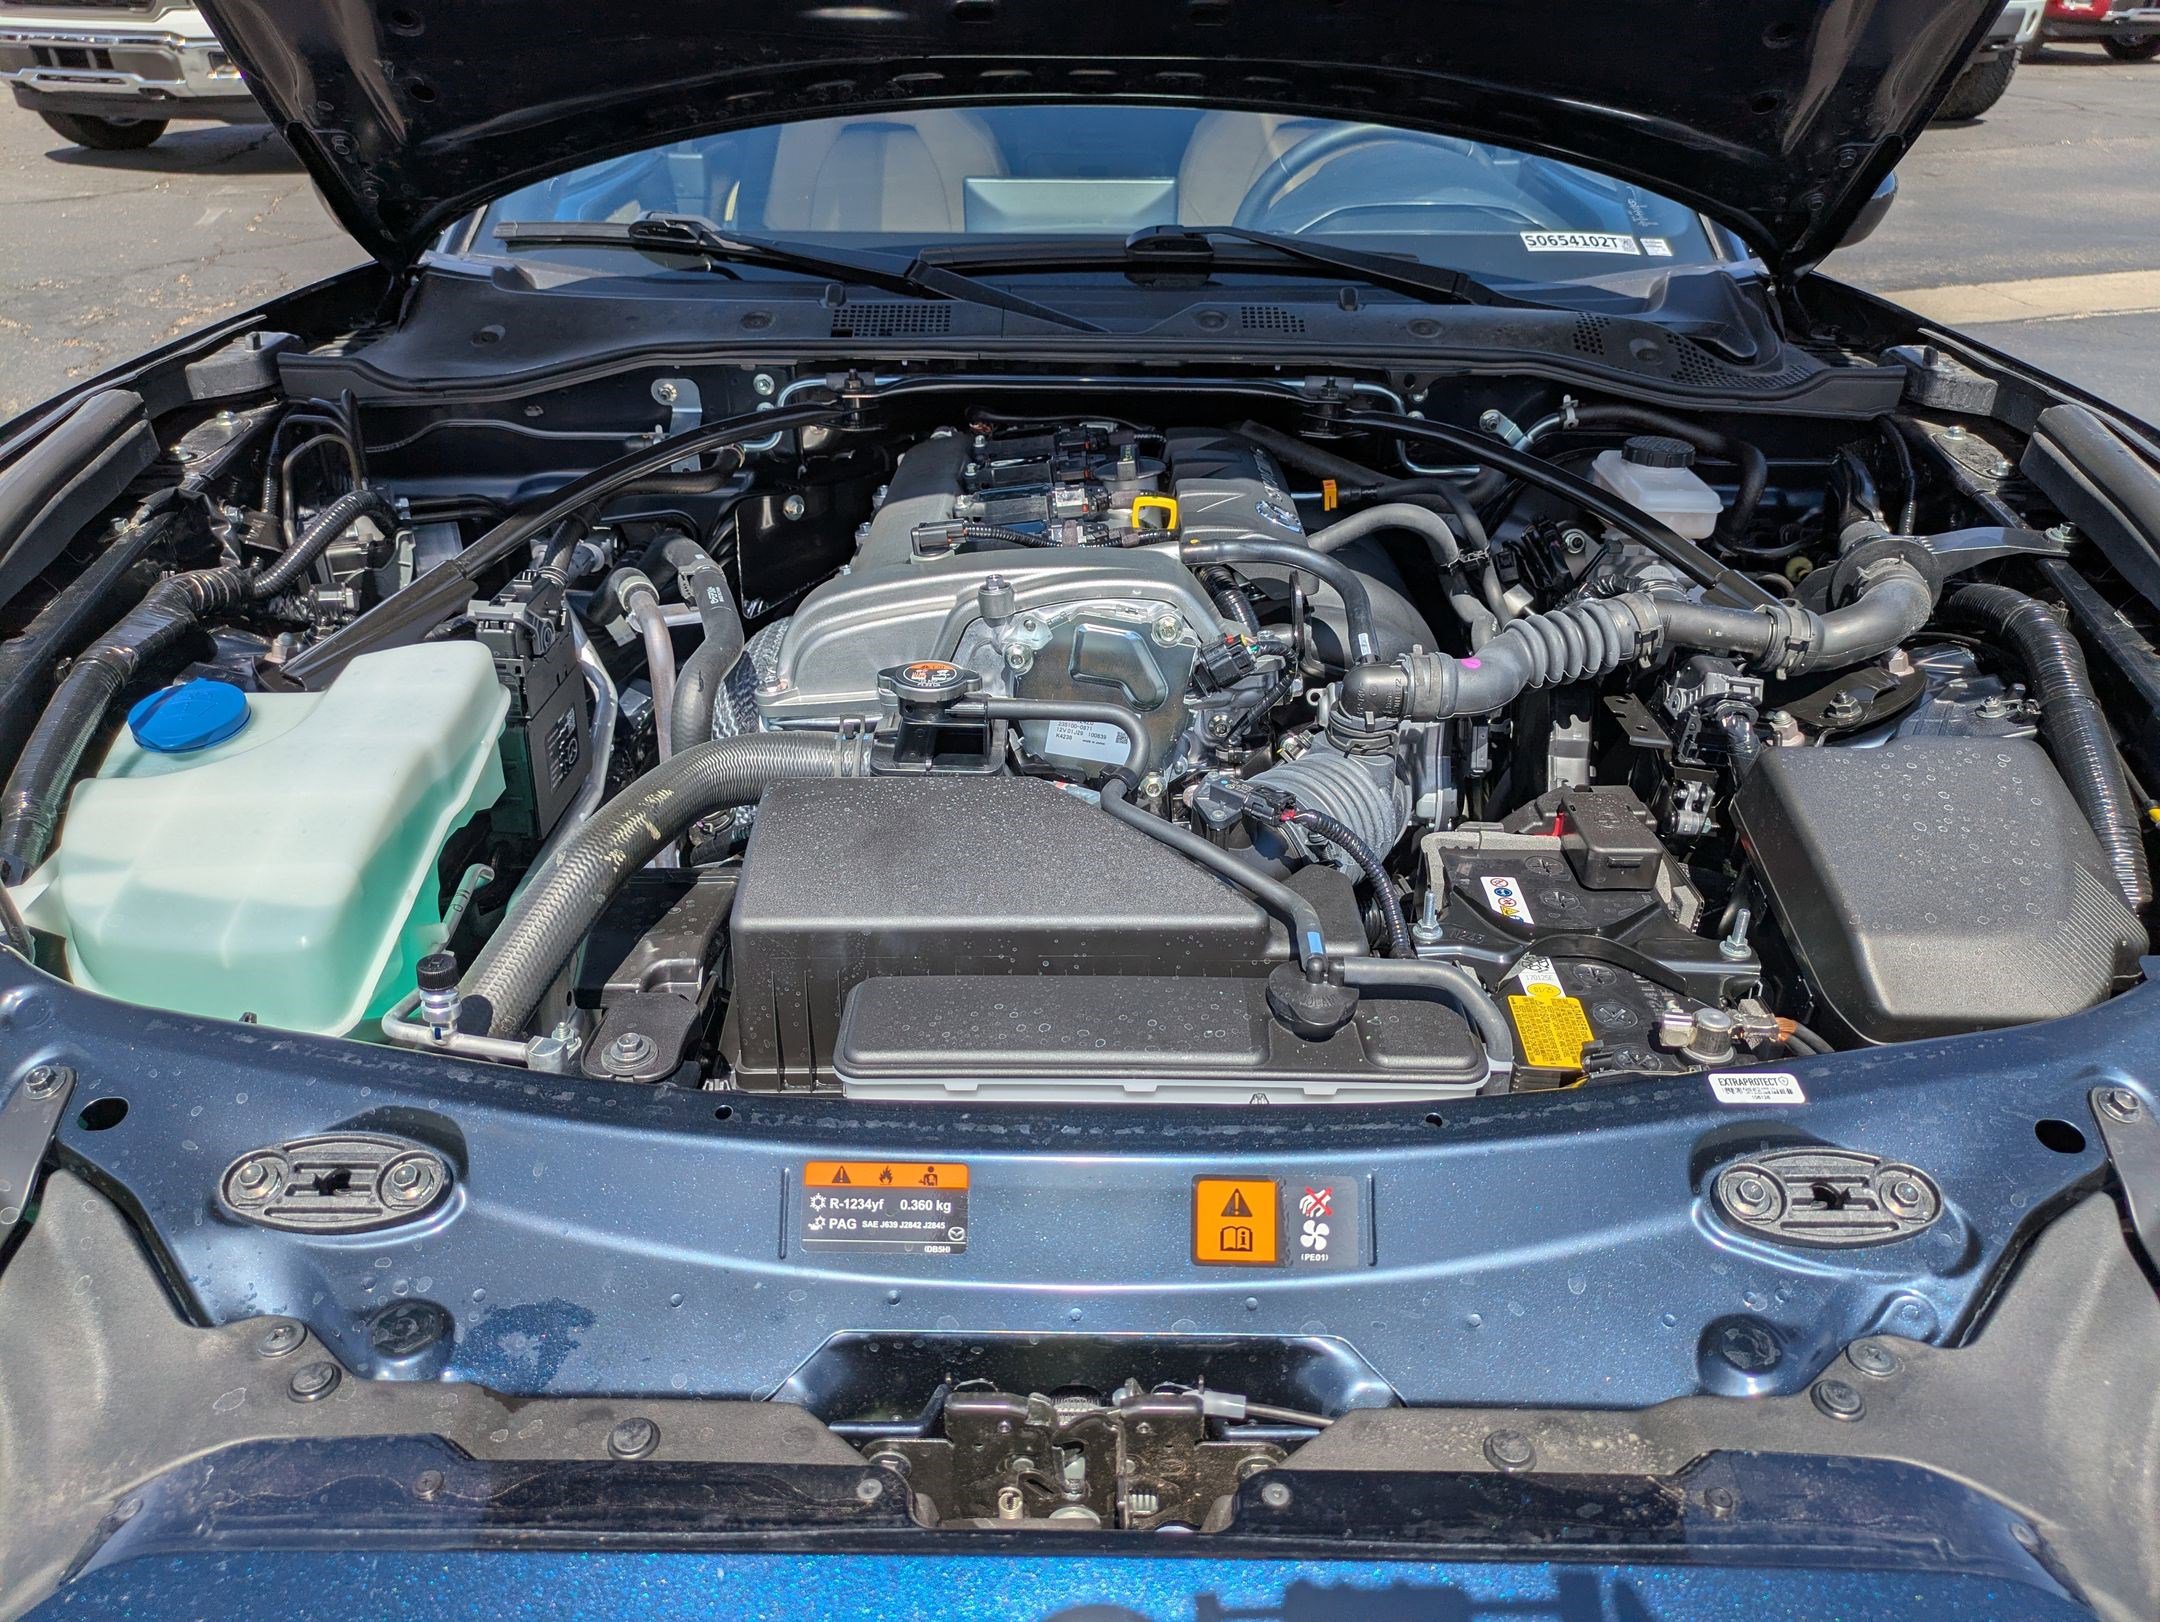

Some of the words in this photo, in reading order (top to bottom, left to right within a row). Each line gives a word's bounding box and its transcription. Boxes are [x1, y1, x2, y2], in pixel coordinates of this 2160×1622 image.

[1718, 1077, 1778, 1086] EXTRAPROTECT
[829, 1198, 885, 1212] R-1234yf
[900, 1199, 932, 1211] 0.360
[936, 1199, 952, 1213] kg
[829, 1218, 857, 1230] PAG
[862, 1220, 878, 1228] SAE
[880, 1220, 898, 1229] J639
[899, 1221, 922, 1229] J2842
[922, 1221, 946, 1230] J2845
